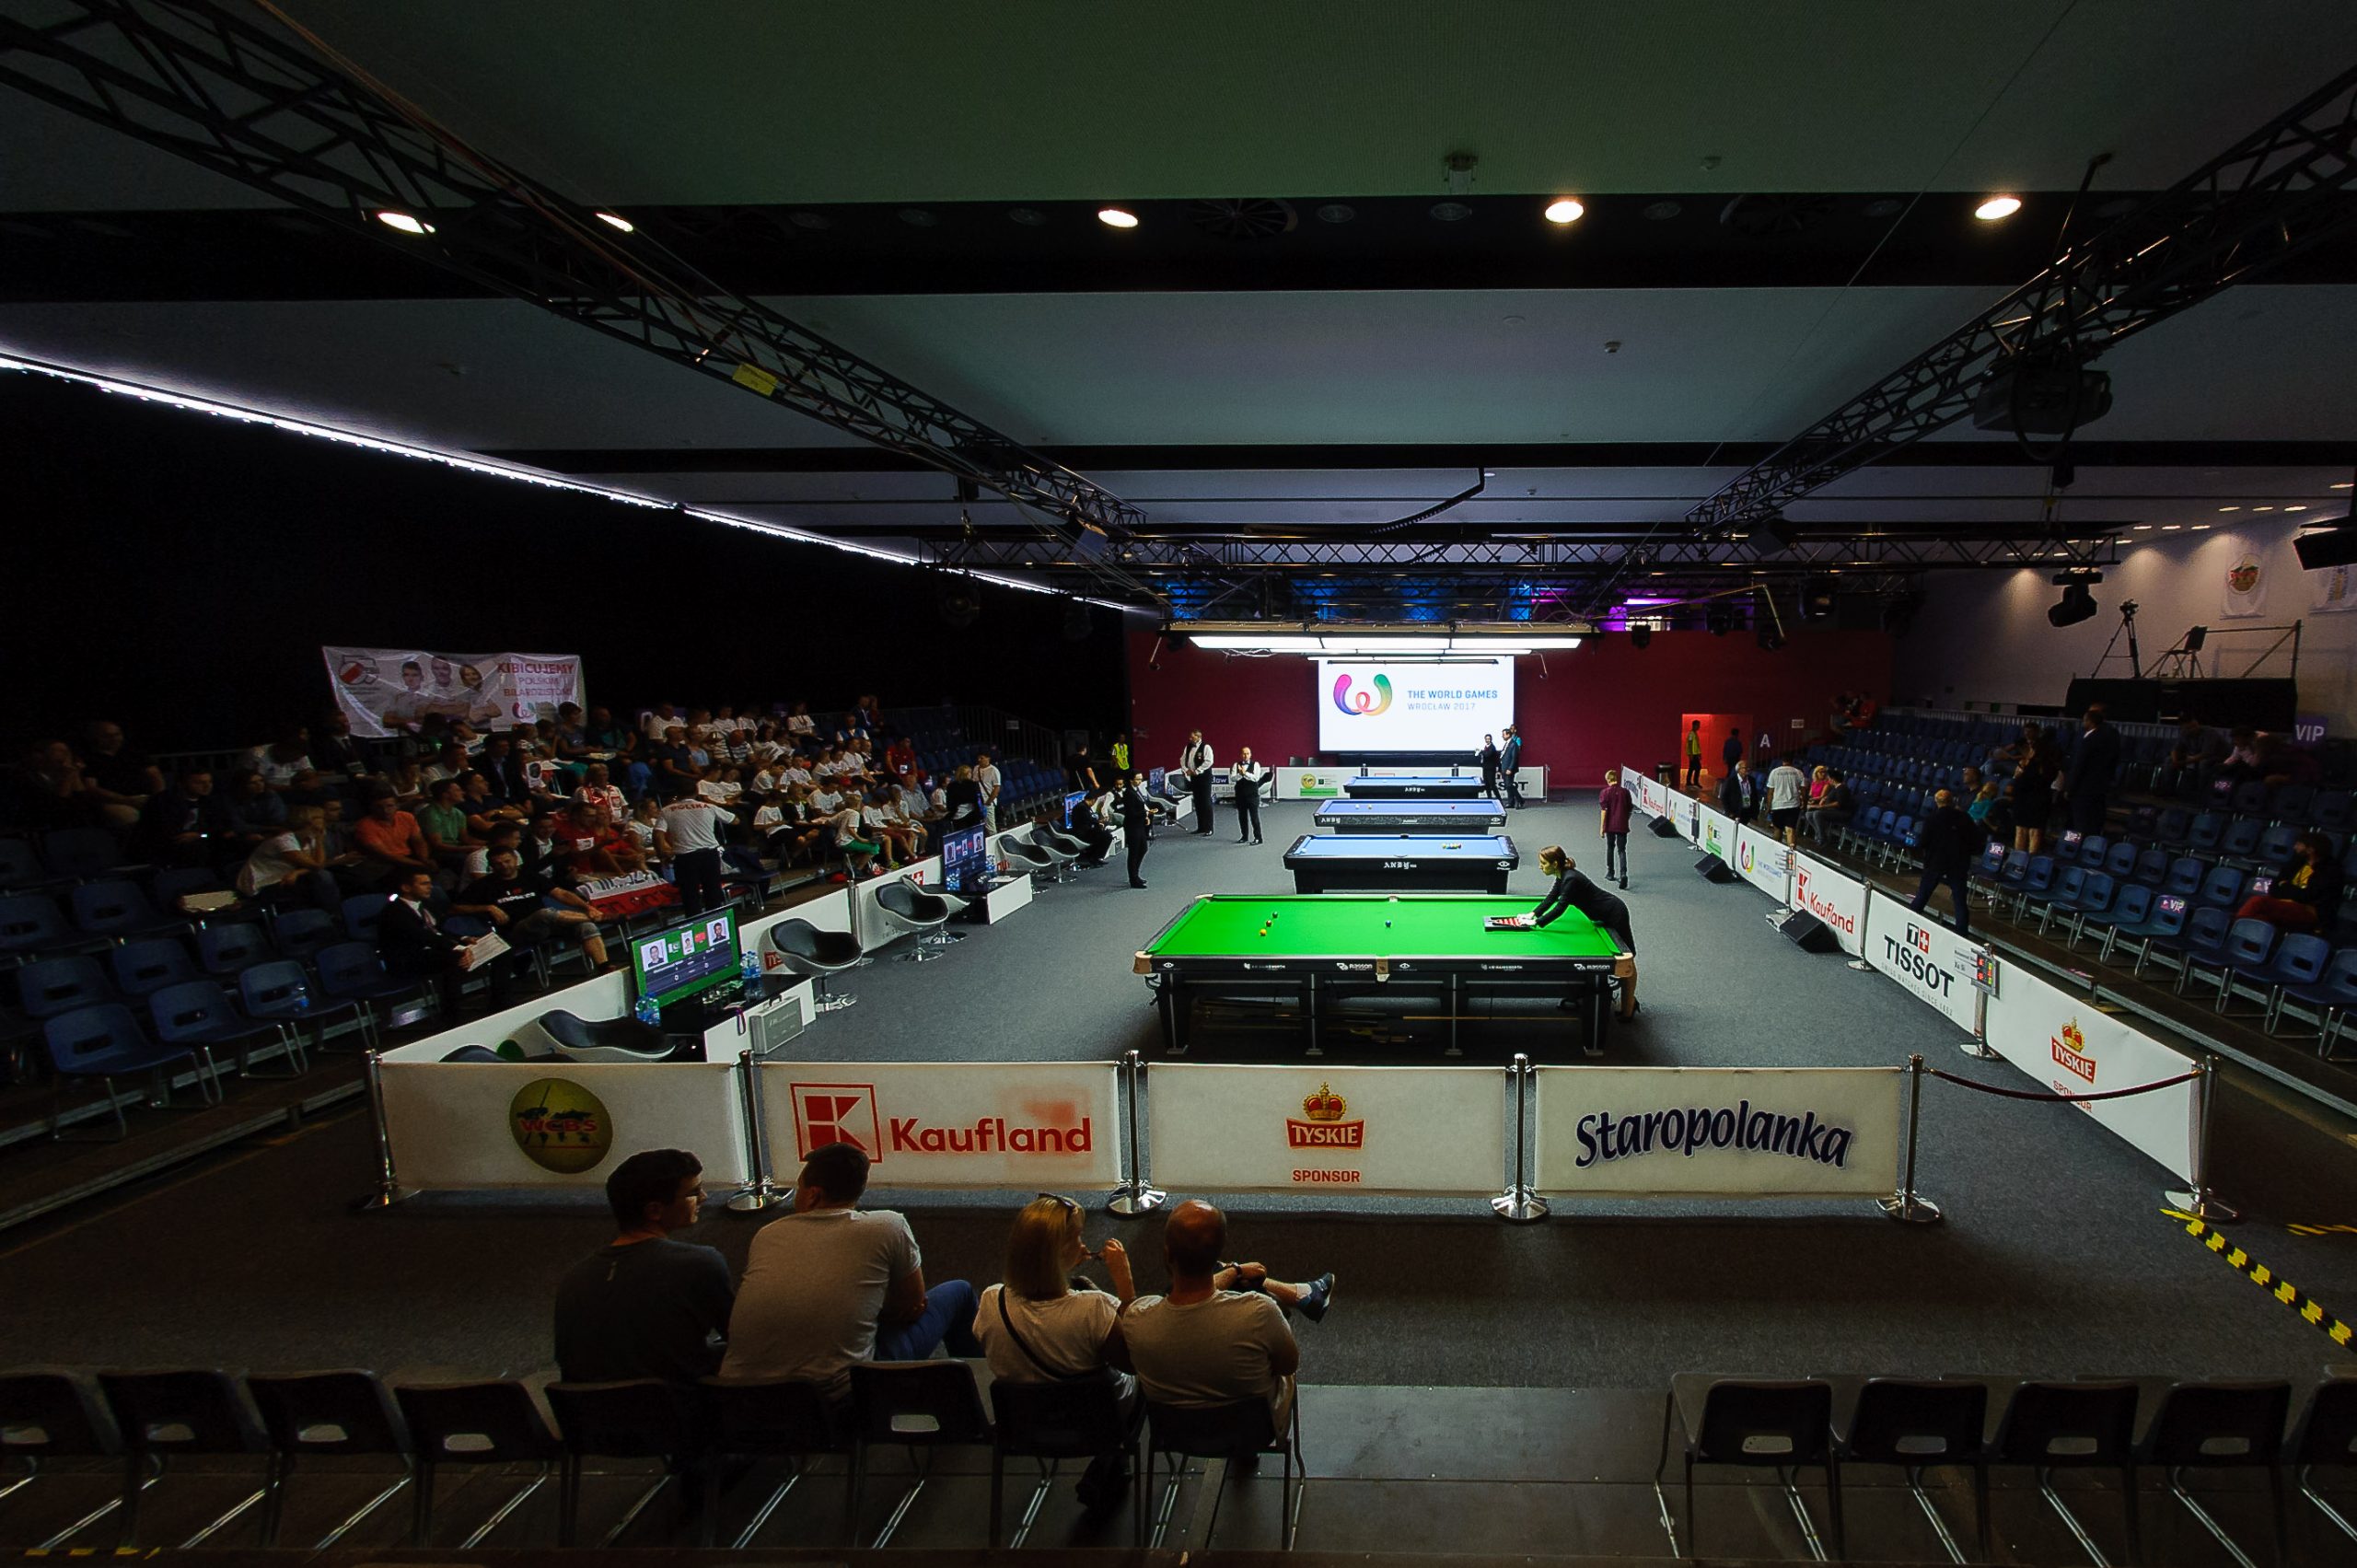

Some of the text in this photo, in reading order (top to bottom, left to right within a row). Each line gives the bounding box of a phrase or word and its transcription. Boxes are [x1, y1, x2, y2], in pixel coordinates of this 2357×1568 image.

[498, 663, 575, 674] KIBICUJEMY
[1408, 690, 1498, 699] THE WORLD GAMES
[1454, 703, 1476, 711] 2017
[1759, 733, 1771, 748] A
[2295, 725, 2325, 741] VIP
[1383, 861, 1410, 870] ANDY
[1810, 891, 1854, 935] Kaufland
[1884, 934, 1955, 998] TISSOT
[2052, 1041, 2093, 1079] TYSKIE
[519, 1120, 598, 1132] WCBS
[891, 1116, 1092, 1153] Kaufland
[1291, 1125, 1360, 1145] TYSKIE
[1575, 1100, 1852, 1168] Staropolanka
[1292, 1170, 1360, 1183] SPONSOR
